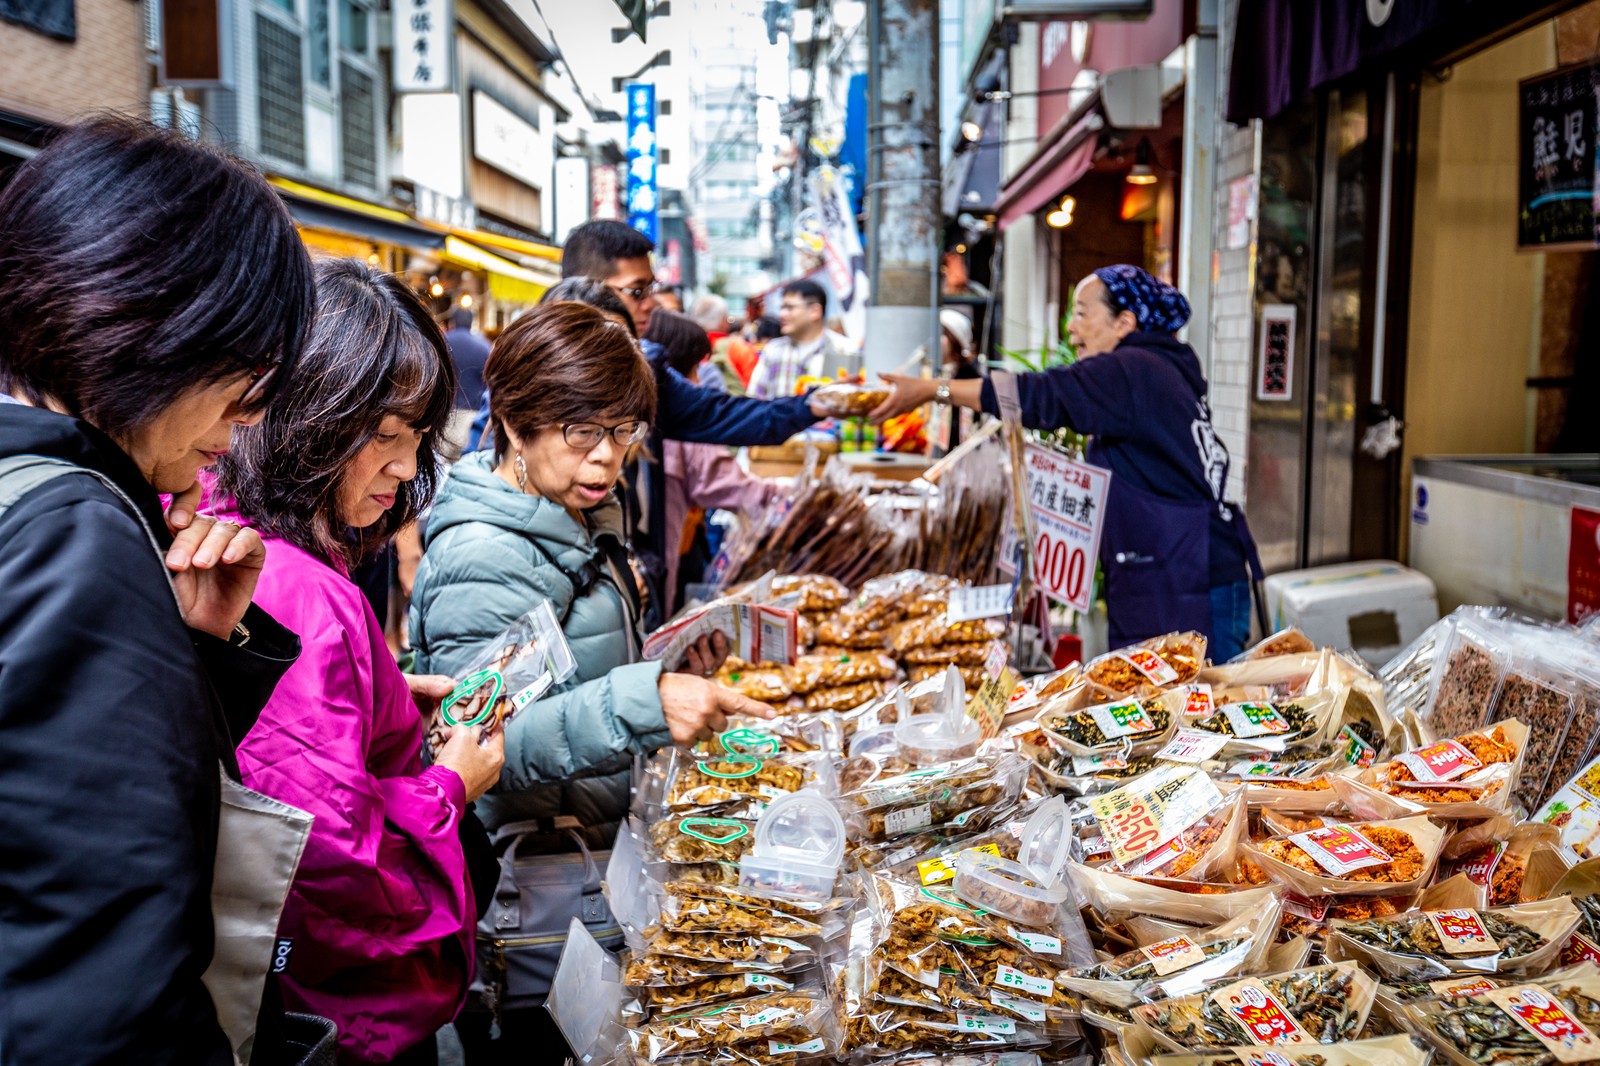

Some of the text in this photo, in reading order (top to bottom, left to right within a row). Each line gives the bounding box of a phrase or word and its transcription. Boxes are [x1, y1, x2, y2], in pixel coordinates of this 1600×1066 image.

[1533, 109, 1587, 170] 鮭児
[1112, 804, 1160, 852] 350
[1321, 835, 1352, 849] かに
[1440, 917, 1477, 927] ミックス
[1242, 1006, 1280, 1025] ミックス
[1524, 1007, 1564, 1025] ミックス
